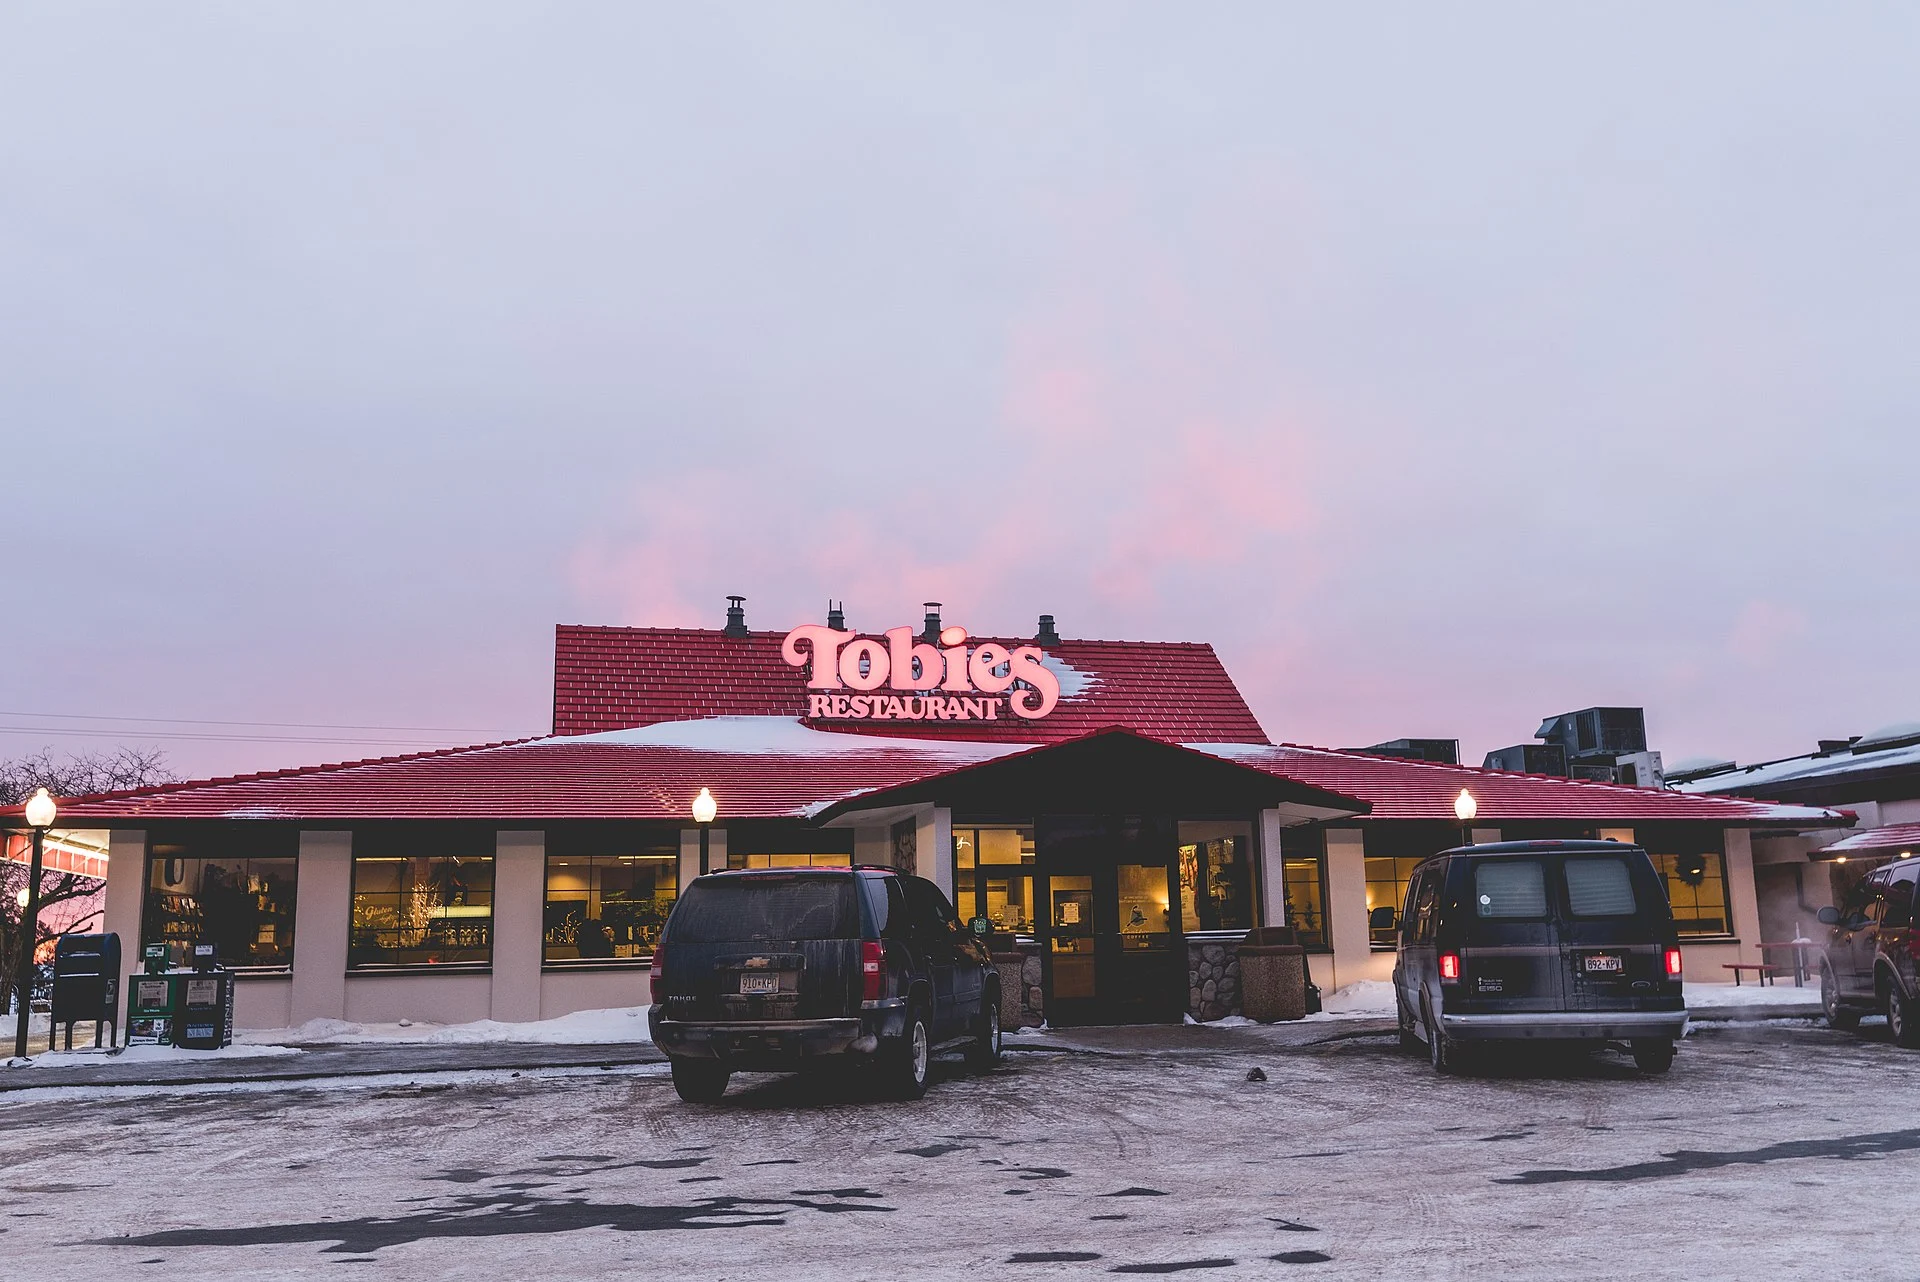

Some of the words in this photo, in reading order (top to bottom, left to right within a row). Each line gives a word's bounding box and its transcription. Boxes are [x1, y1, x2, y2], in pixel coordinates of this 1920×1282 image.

[781, 624, 1060, 719] Tobies
[809, 694, 1002, 720] RESTAURANT
[365, 905, 393, 920] Gluten
[1587, 959, 1621, 970] 892-KPV
